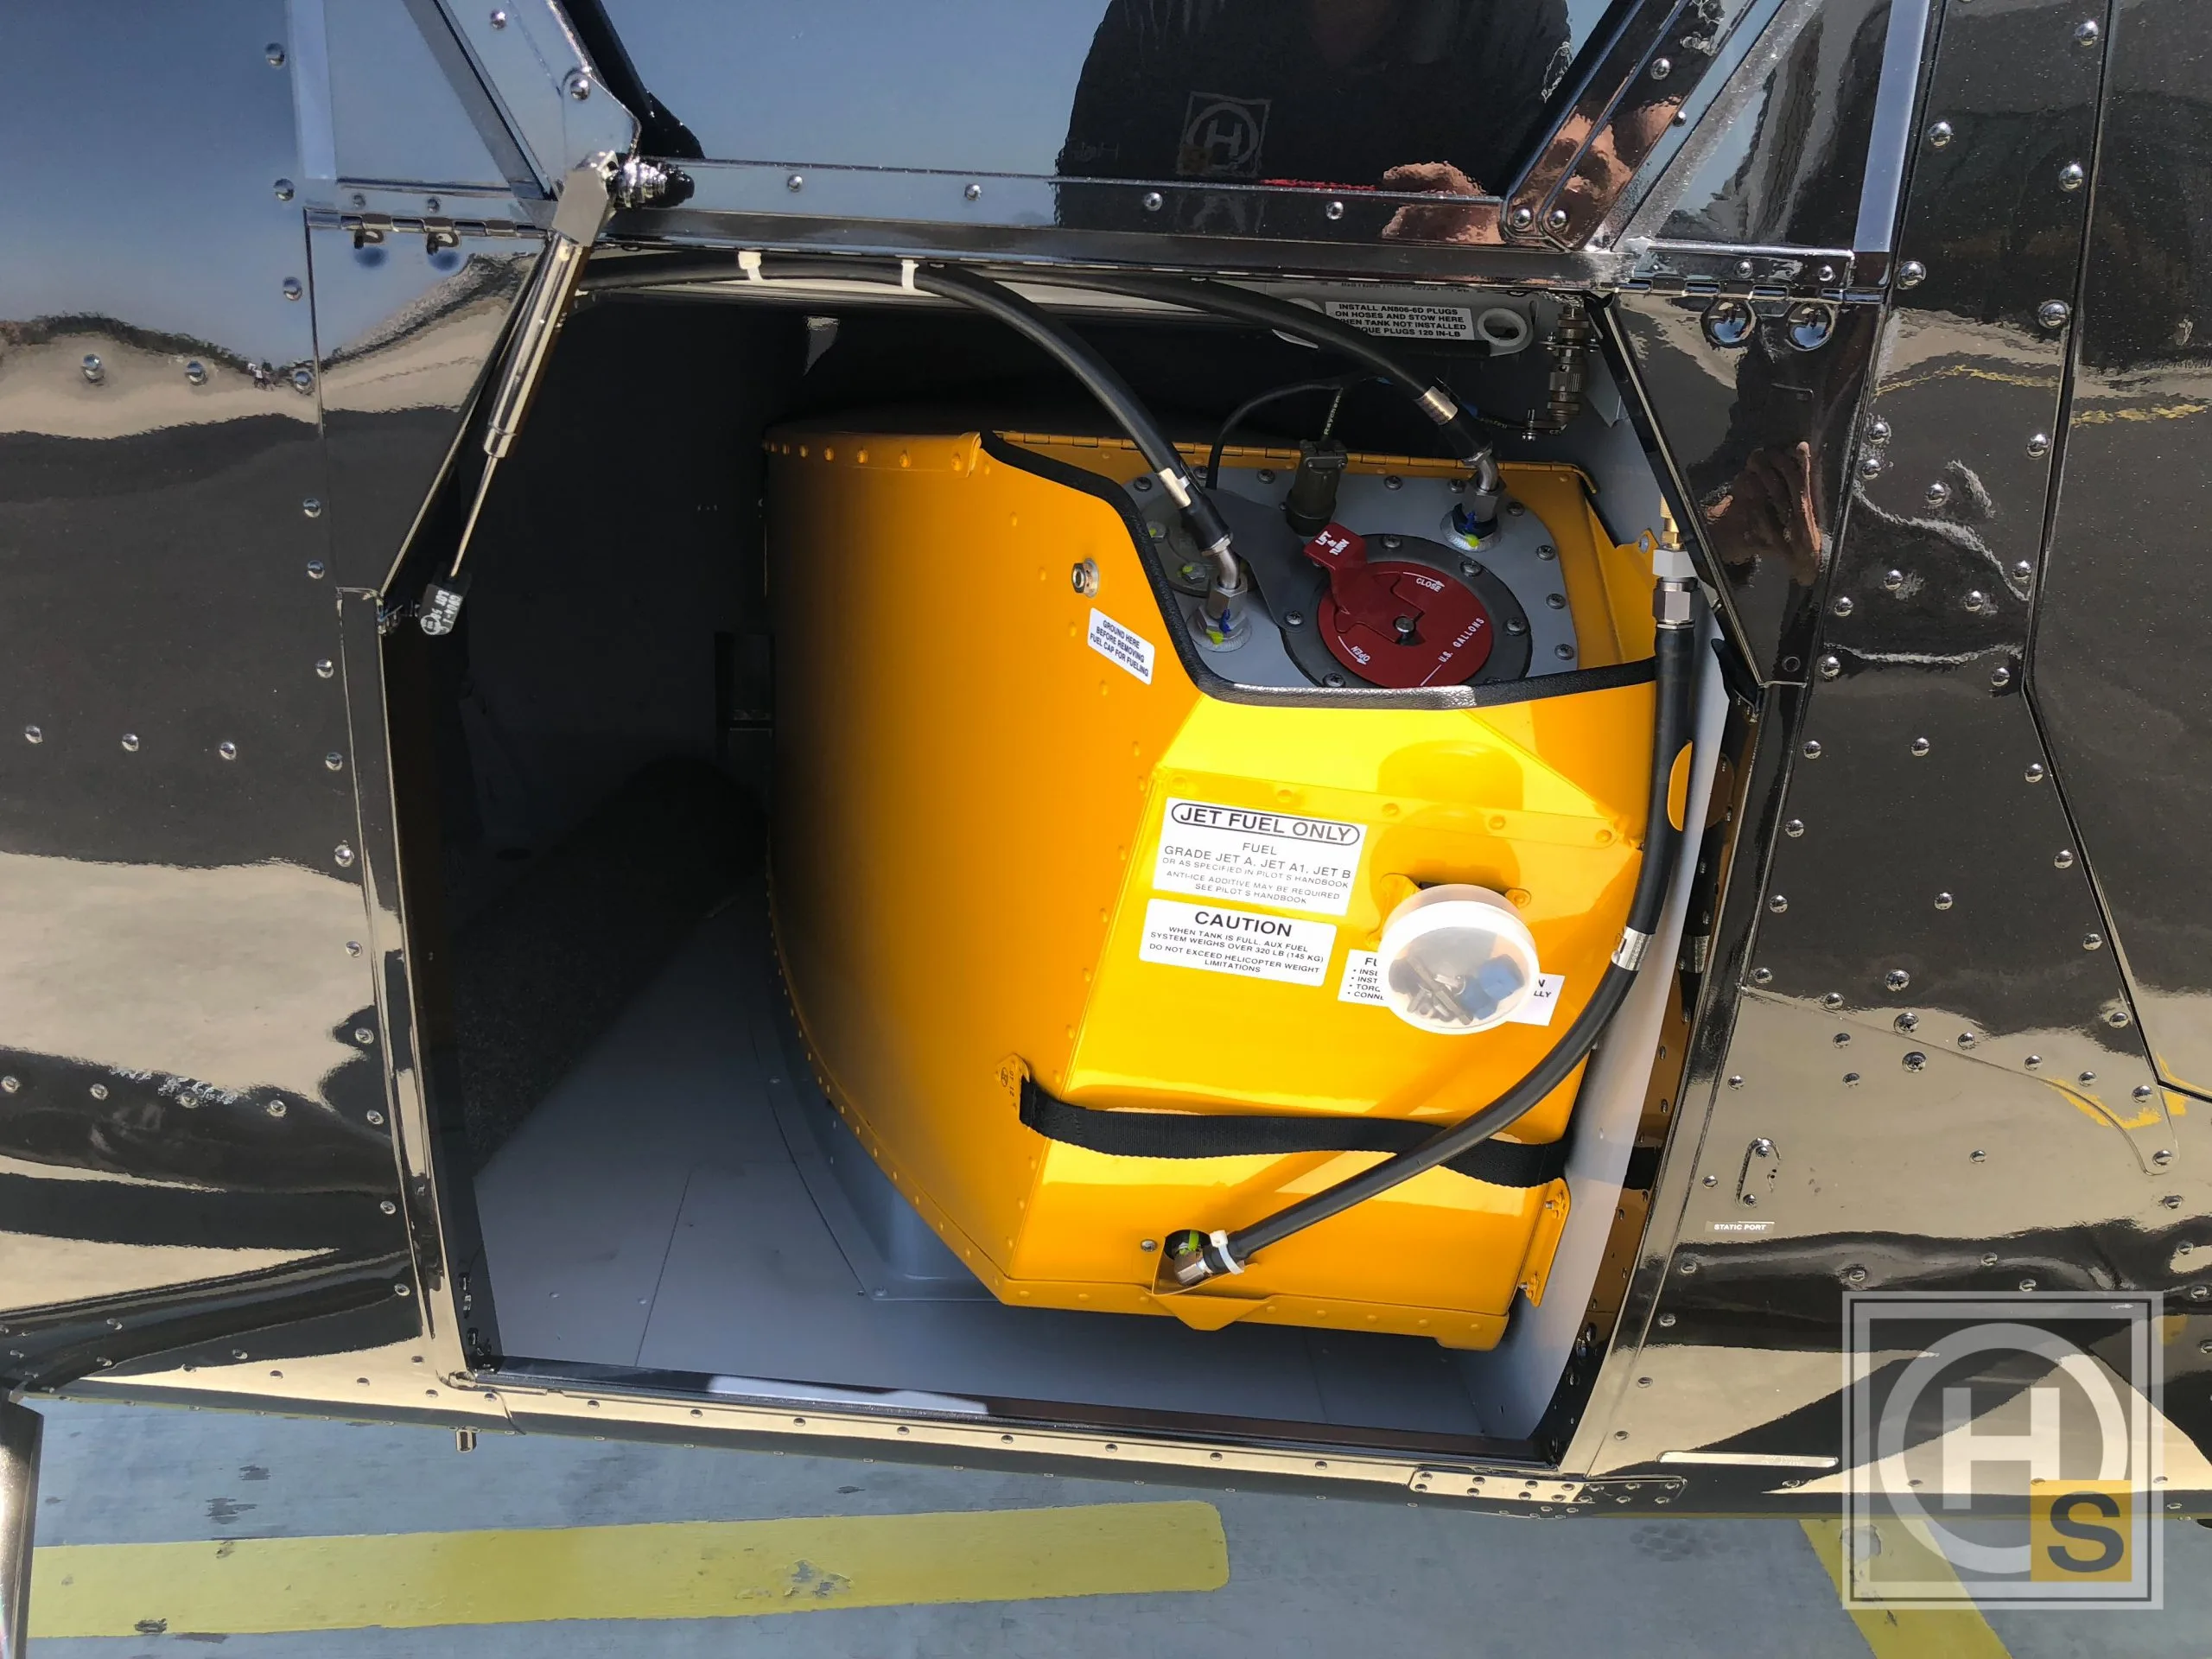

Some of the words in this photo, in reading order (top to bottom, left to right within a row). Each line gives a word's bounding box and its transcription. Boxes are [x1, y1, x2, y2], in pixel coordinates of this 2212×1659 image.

[1329, 539, 1350, 555] TURN
[1416, 577, 1442, 592] CLOSE
[1096, 626, 1116, 645] BEFORE
[1118, 639, 1144, 663] REMOVING
[1103, 620, 1124, 639] GROUND
[1126, 634, 1140, 649] HERE
[1438, 651, 1452, 663] U.S.
[1452, 618, 1484, 648] GALLONS
[1090, 633, 1103, 646] FUEL
[1104, 642, 1115, 652] CAP
[1115, 650, 1126, 662] FOR
[1127, 657, 1148, 677] FUELING
[1351, 645, 1370, 662] OPEN
[1180, 807, 1222, 825] JET
[1229, 814, 1284, 834] FUEL
[1293, 822, 1351, 842] ONLY
[1243, 842, 1277, 855] FUEL
[1164, 846, 1211, 860] GRADE
[1216, 853, 1241, 864] JET
[1261, 859, 1286, 869] JET
[1313, 866, 1339, 877] JET
[1342, 870, 1351, 879] B
[1194, 861, 1243, 874] SPECIFIED
[1295, 875, 1349, 888] HANDBOOK
[1166, 871, 1205, 881] ANTI-ICE
[1208, 875, 1250, 887] ADDITIVE
[1291, 887, 1339, 899] REQUIRED
[1195, 883, 1212, 892] SEE
[1254, 892, 1306, 904] HANDBOOK
[1195, 912, 1292, 937] CAUTION
[1150, 931, 1187, 943] SYSTEM
[1190, 938, 1225, 948] WEIGHS
[1228, 943, 1253, 952] OVER
[1287, 951, 1305, 961] (145
[1307, 954, 1324, 963] KG)
[1169, 926, 1197, 937] WHEN
[1198, 931, 1223, 940] TANK
[1286, 943, 1308, 952] FUEL
[1165, 945, 1184, 954] NOT
[1186, 949, 1222, 959] EXCEED
[1224, 954, 1282, 968] HELICOPTER
[1285, 963, 1320, 973] WEIGHT
[1205, 960, 1261, 973] LIMITATIONS
